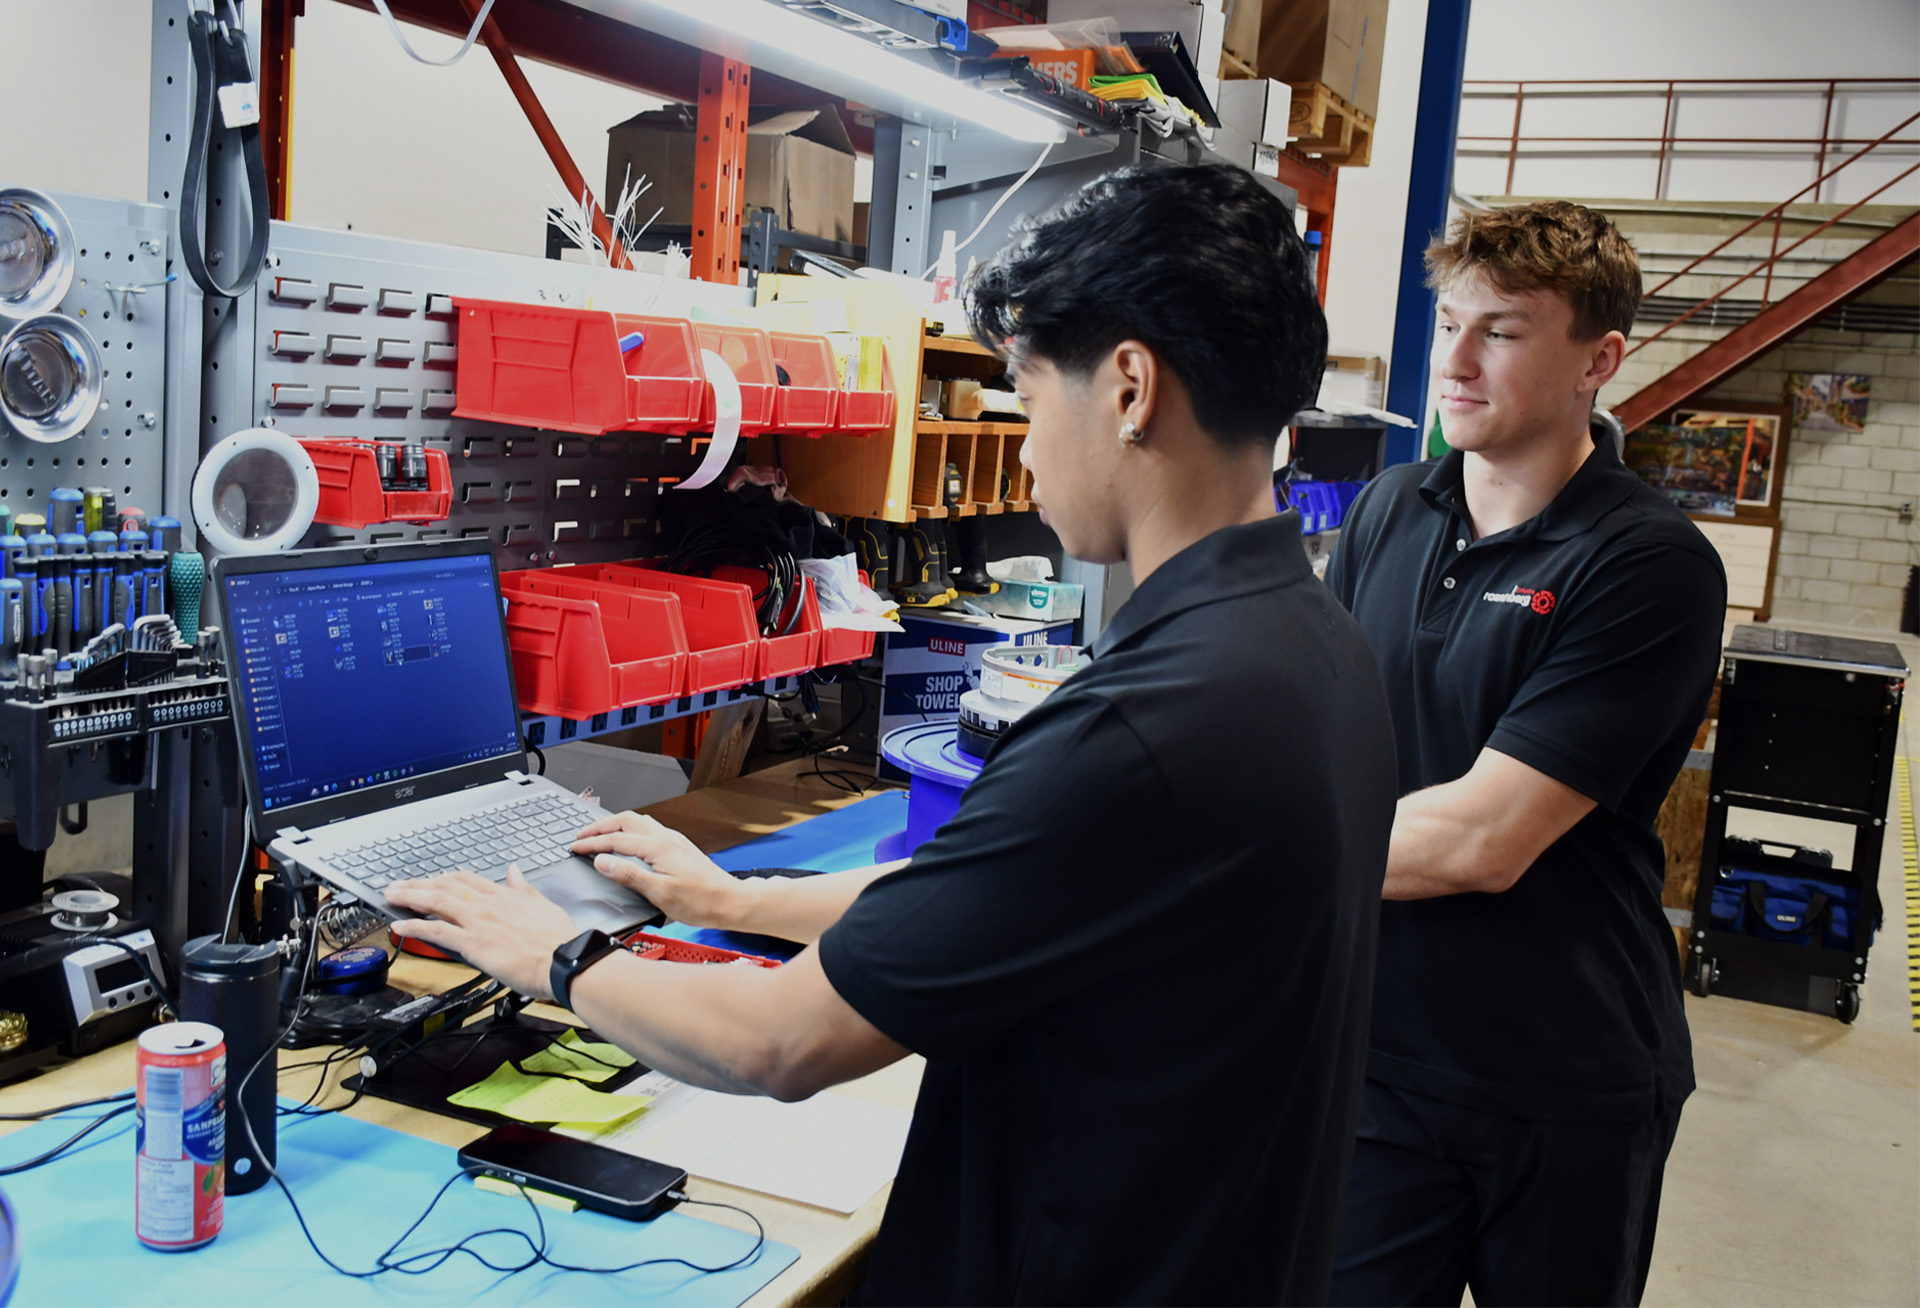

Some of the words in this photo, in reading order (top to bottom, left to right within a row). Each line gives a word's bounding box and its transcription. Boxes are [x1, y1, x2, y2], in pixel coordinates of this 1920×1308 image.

[930, 638, 964, 655] ULINE
[925, 675, 964, 692] SHOP
[395, 785, 416, 799] acer
